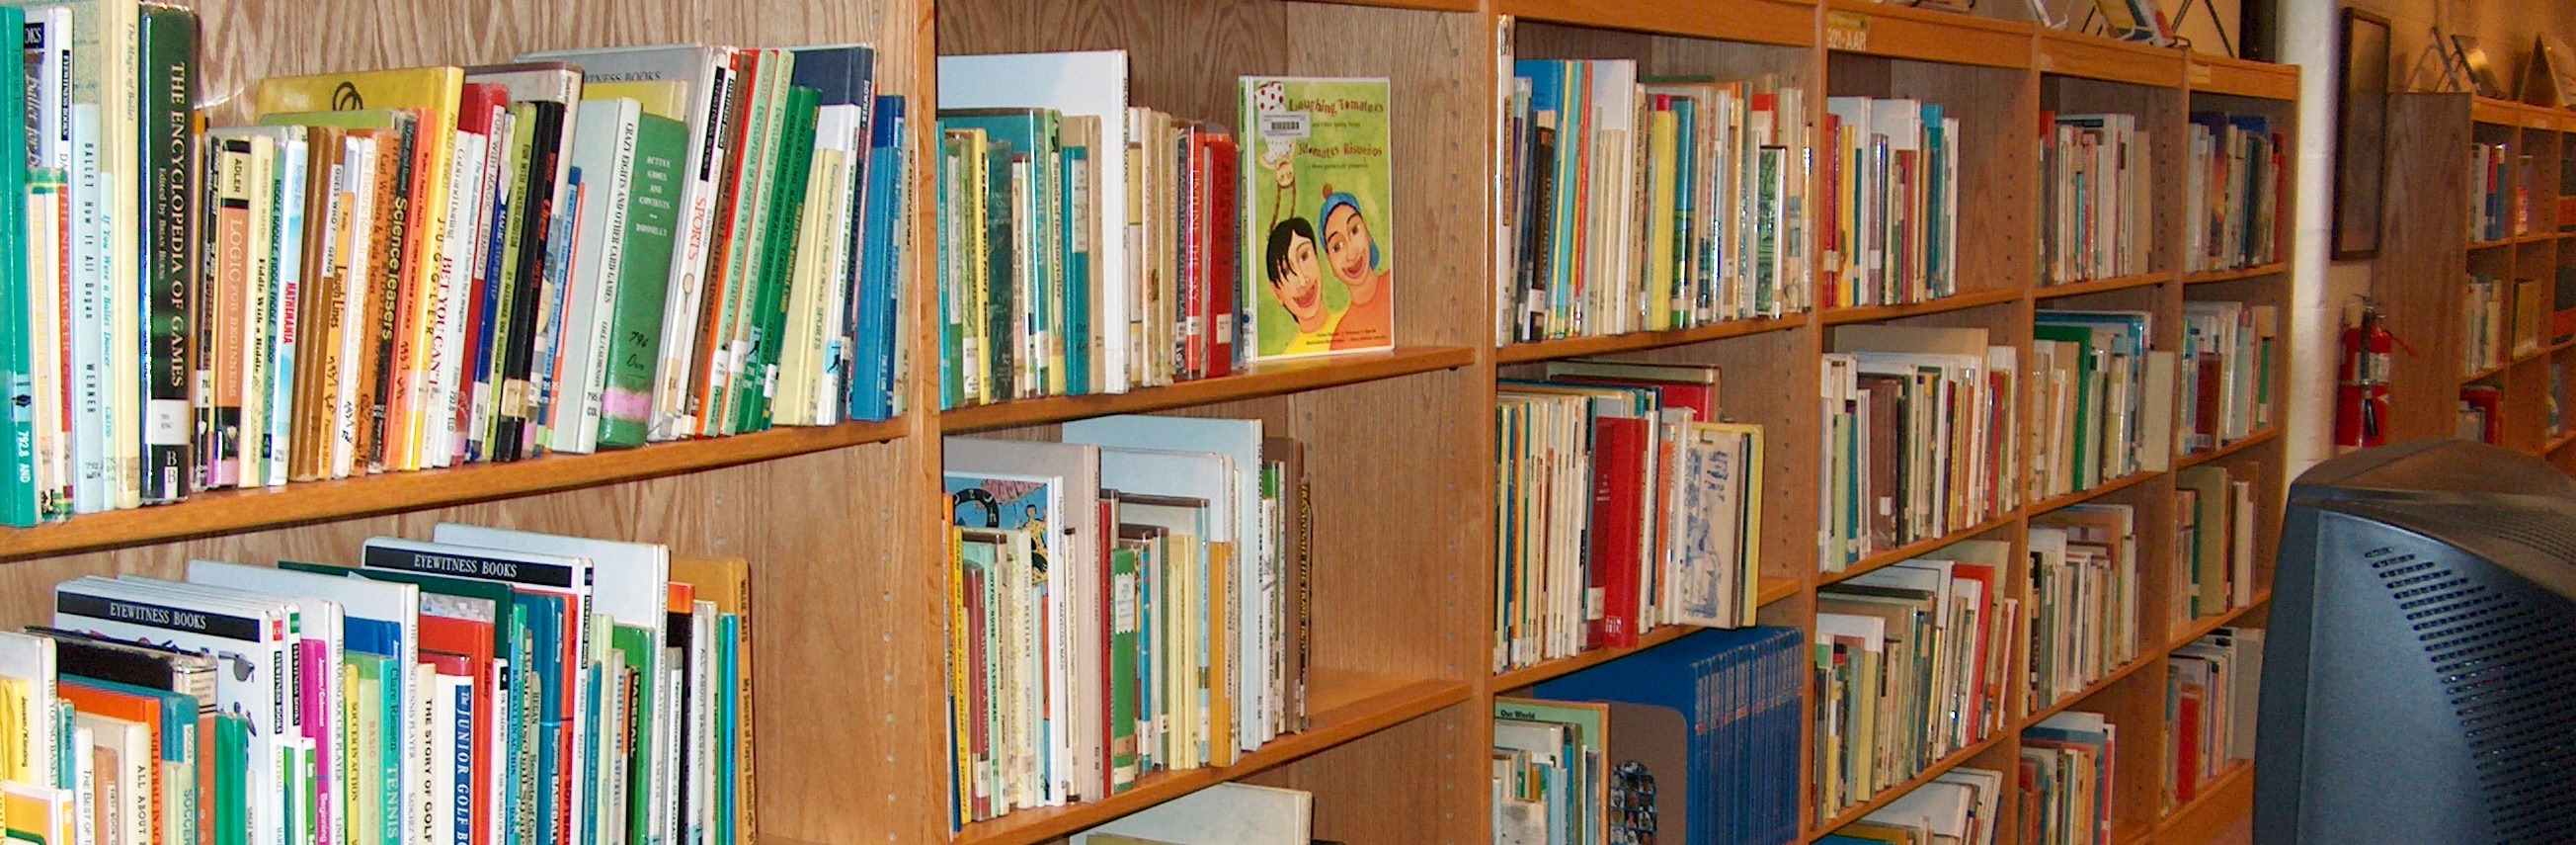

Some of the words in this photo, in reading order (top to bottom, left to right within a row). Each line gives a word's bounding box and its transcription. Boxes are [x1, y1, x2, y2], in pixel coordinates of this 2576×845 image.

[126, 44, 135, 76] Magic
[171, 61, 186, 105] THE
[625, 71, 661, 81] BOOKS
[1288, 99, 1337, 117] Laughing
[494, 113, 503, 134] FUN
[622, 123, 634, 152] CRAZY
[749, 105, 763, 164] ENCYCLOPEDIA
[766, 107, 782, 166] ENCYCLOPEDIA
[85, 143, 95, 188] BALLET
[489, 142, 499, 168] WITH
[522, 144, 531, 160] FUN
[233, 158, 242, 193] ADLER
[520, 163, 529, 183] WITH
[617, 154, 630, 188] EIGHTS
[171, 111, 185, 274] ENCYCLOPEDIA
[484, 172, 495, 211] MAGIC
[615, 192, 626, 210] AND
[743, 182, 754, 211] SPORTS
[761, 182, 772, 211] SPORTS
[85, 202, 94, 224] How
[102, 215, 111, 225] If
[612, 211, 624, 243] OTHER
[85, 235, 94, 245] It
[389, 198, 408, 267] Science
[687, 197, 707, 261] SPORTS
[737, 226, 747, 240] THE
[756, 227, 765, 241] THE
[85, 256, 95, 272] All
[229, 218, 243, 281] LOGIC
[608, 245, 619, 269] CARD
[731, 247, 743, 276] UNITED
[749, 247, 763, 276] UNITED
[334, 265, 347, 298] Laugh
[440, 257, 452, 289] BET
[604, 272, 614, 303] GAMES
[84, 283, 95, 319] Began
[171, 281, 184, 310] OF
[230, 285, 239, 312] FOR
[727, 279, 739, 308] STATES
[746, 279, 757, 308] STATES
[330, 300, 344, 328] Lines
[436, 296, 448, 332] YOU
[171, 316, 184, 387] GAMES
[229, 316, 239, 397] BEGINNERS
[429, 336, 443, 385] CAN'T
[86, 364, 97, 413] WERNER
[415, 553, 478, 573] EYEWITNESS
[482, 561, 518, 577] BOOKS
[110, 603, 170, 625] EYEWITNESS
[174, 611, 206, 631] BOOKS
[630, 674, 640, 758] BASEBALL
[1500, 710, 1513, 718] Our
[1514, 710, 1535, 719] World
[456, 709, 470, 775] JUNIOR
[83, 771, 92, 789] THE
[425, 780, 432, 797] OF
[528, 754, 537, 804] Secrets
[83, 793, 92, 818] BEST
[387, 763, 399, 838] TENNIS
[456, 783, 469, 824] GOLF
[550, 776, 559, 844] BASEBALL
[318, 793, 328, 842] Beginning
